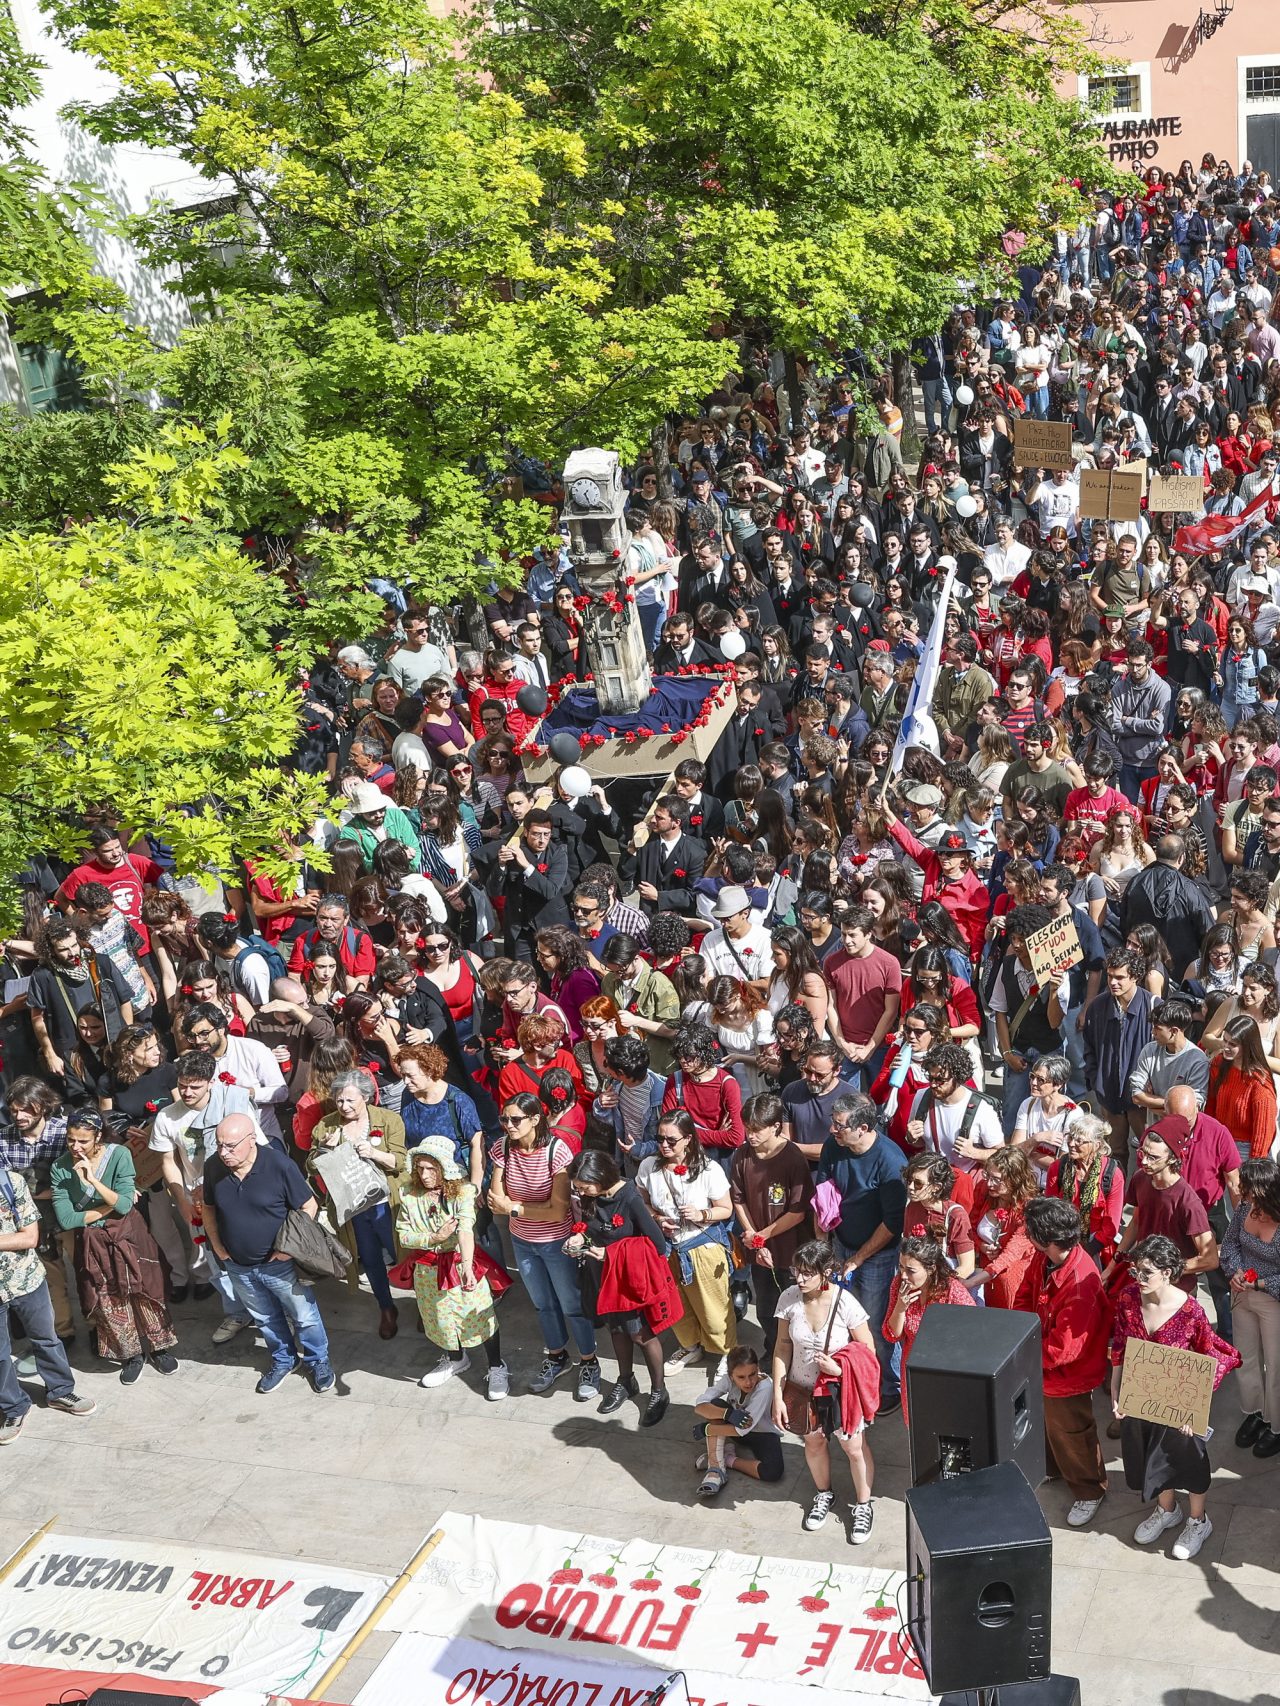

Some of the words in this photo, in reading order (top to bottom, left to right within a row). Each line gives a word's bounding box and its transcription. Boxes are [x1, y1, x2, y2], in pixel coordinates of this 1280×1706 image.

[1027, 928, 1049, 951] ELES
[1041, 931, 1066, 953] TUDO
[1051, 949, 1056, 958] E
[1036, 962, 1051, 976] NÃO
[1133, 1342, 1146, 1364] A
[1140, 1399, 1195, 1427] COLETIVA
[495, 1582, 699, 1650] FUTURO
[201, 1654, 230, 1677] O
